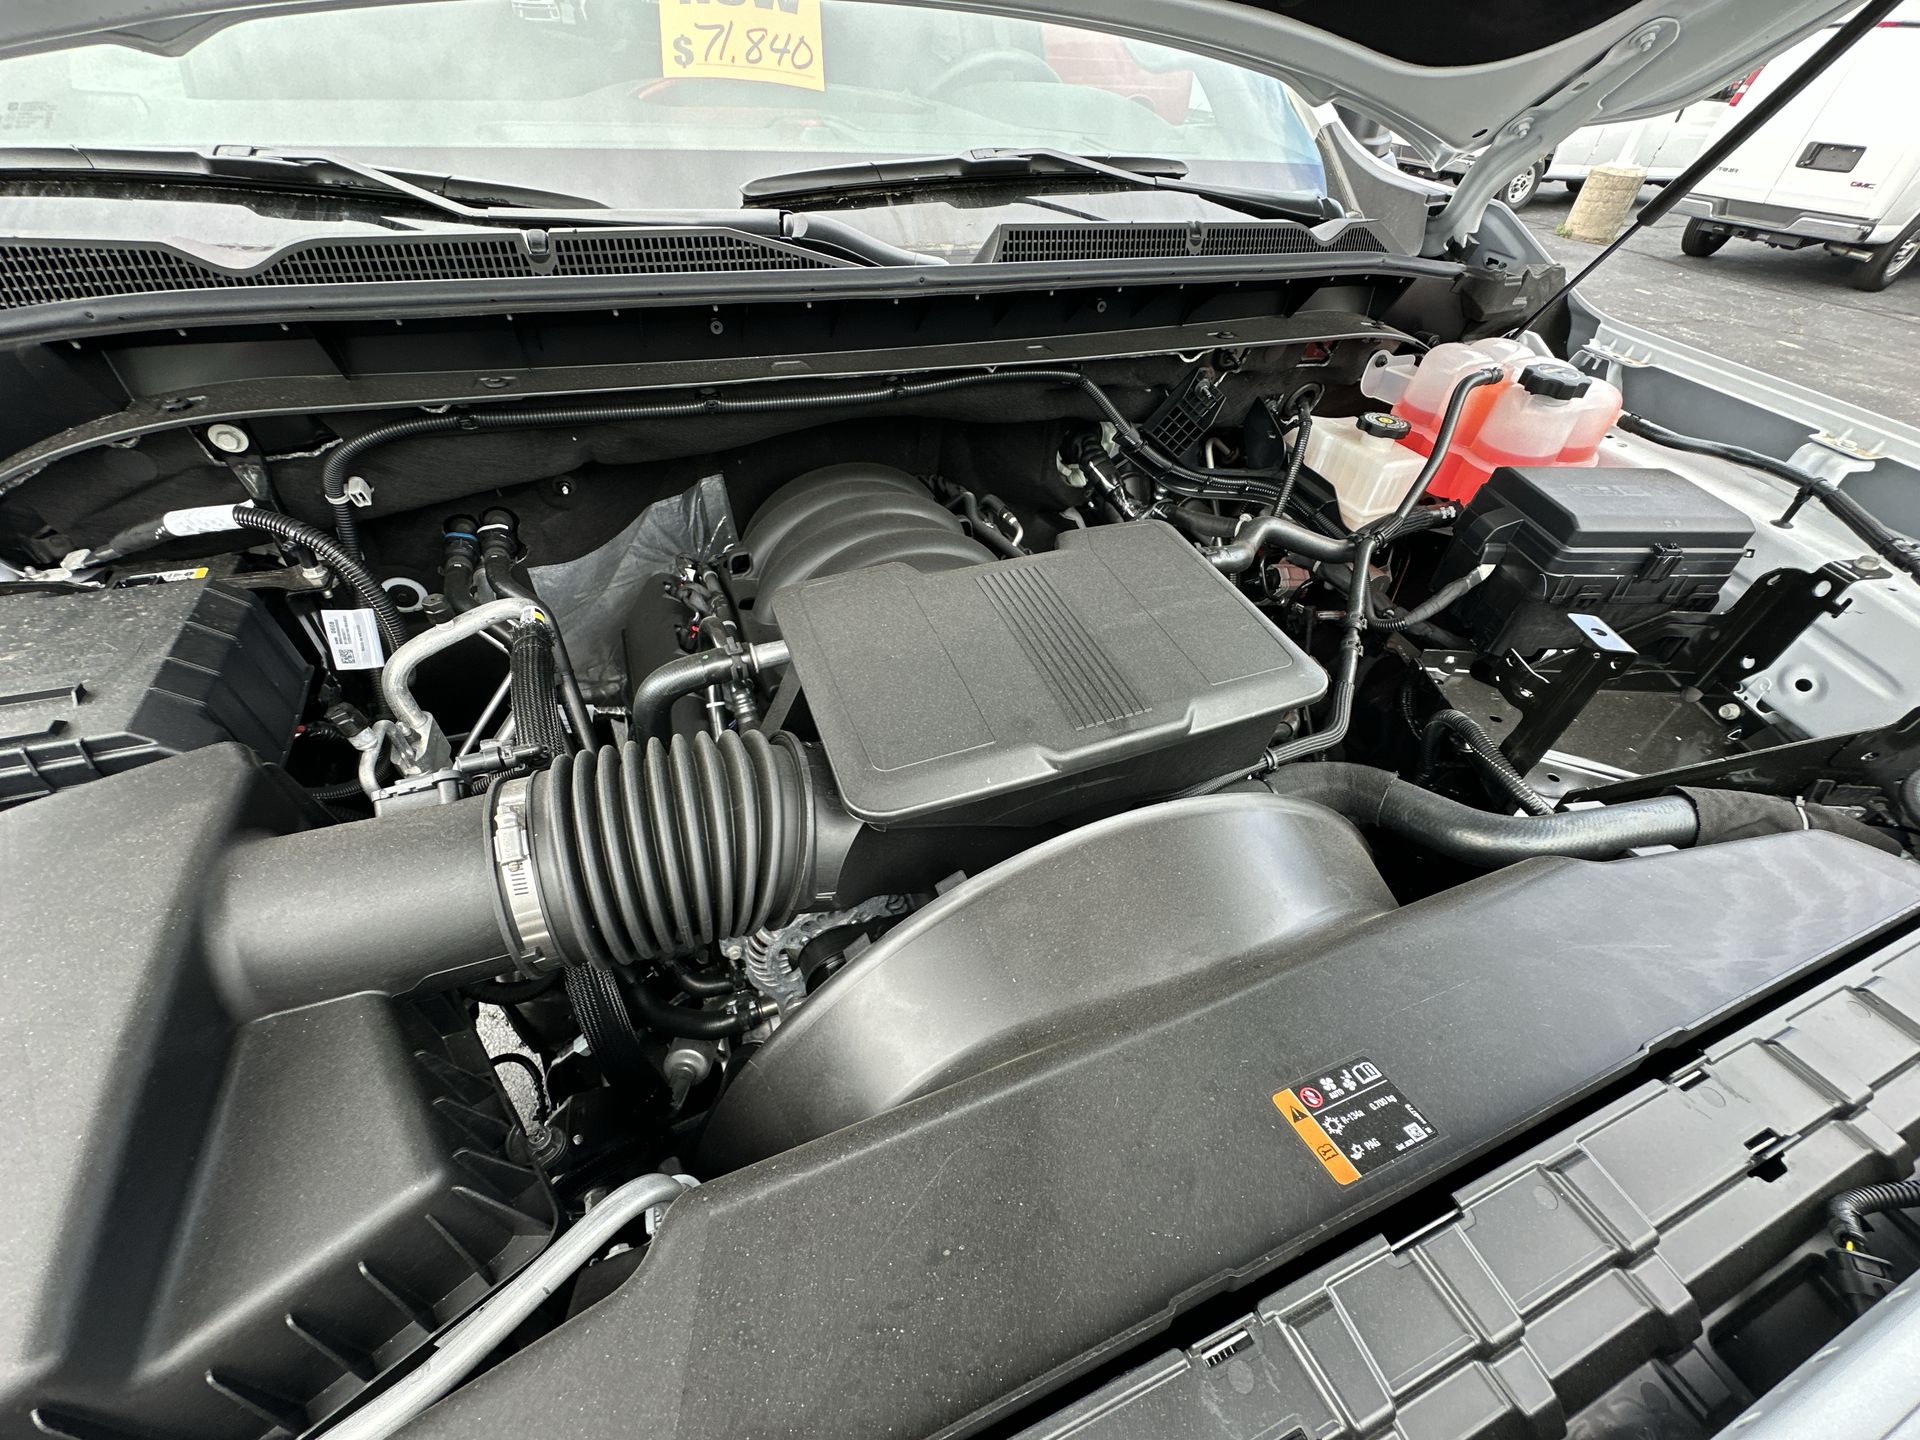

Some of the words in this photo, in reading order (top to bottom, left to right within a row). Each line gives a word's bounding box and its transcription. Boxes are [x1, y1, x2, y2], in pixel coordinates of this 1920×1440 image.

[1328, 1088, 1345, 1100] AUTO
[1340, 1109, 1366, 1124] R-134a
[1368, 1097, 1389, 1111] 0.700
[1385, 1094, 1398, 1103] kg
[1363, 1137, 1381, 1151] PAG
